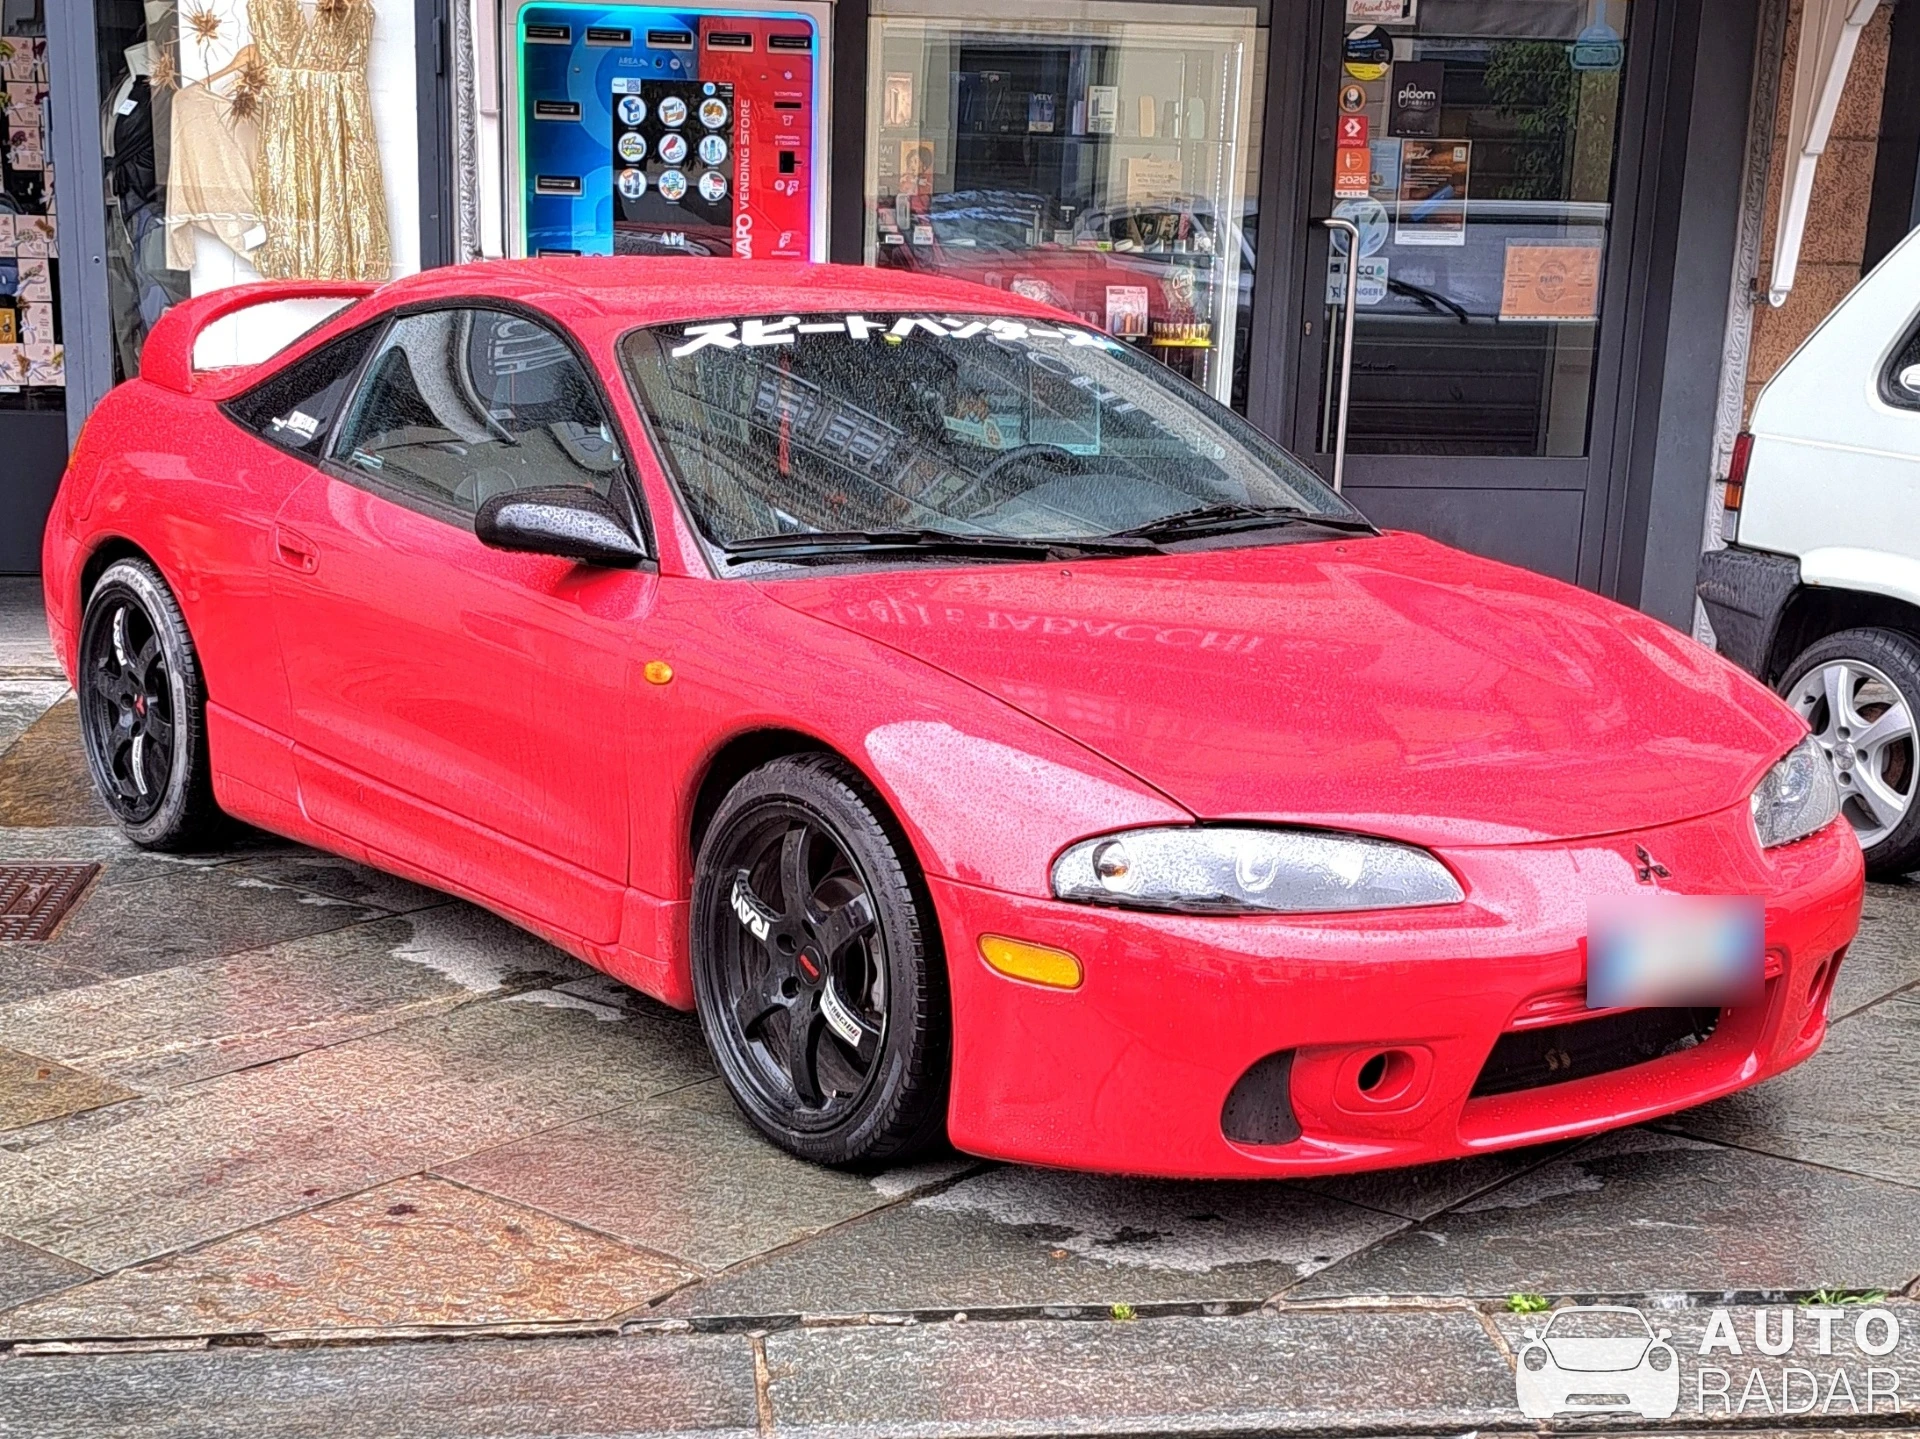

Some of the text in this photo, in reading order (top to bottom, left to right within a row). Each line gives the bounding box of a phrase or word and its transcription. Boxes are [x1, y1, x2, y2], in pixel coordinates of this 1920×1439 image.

[1398, 82, 1436, 108] ploom
[740, 99, 751, 146] STORE
[739, 148, 750, 211] VENDING
[1338, 175, 1367, 185] 2026
